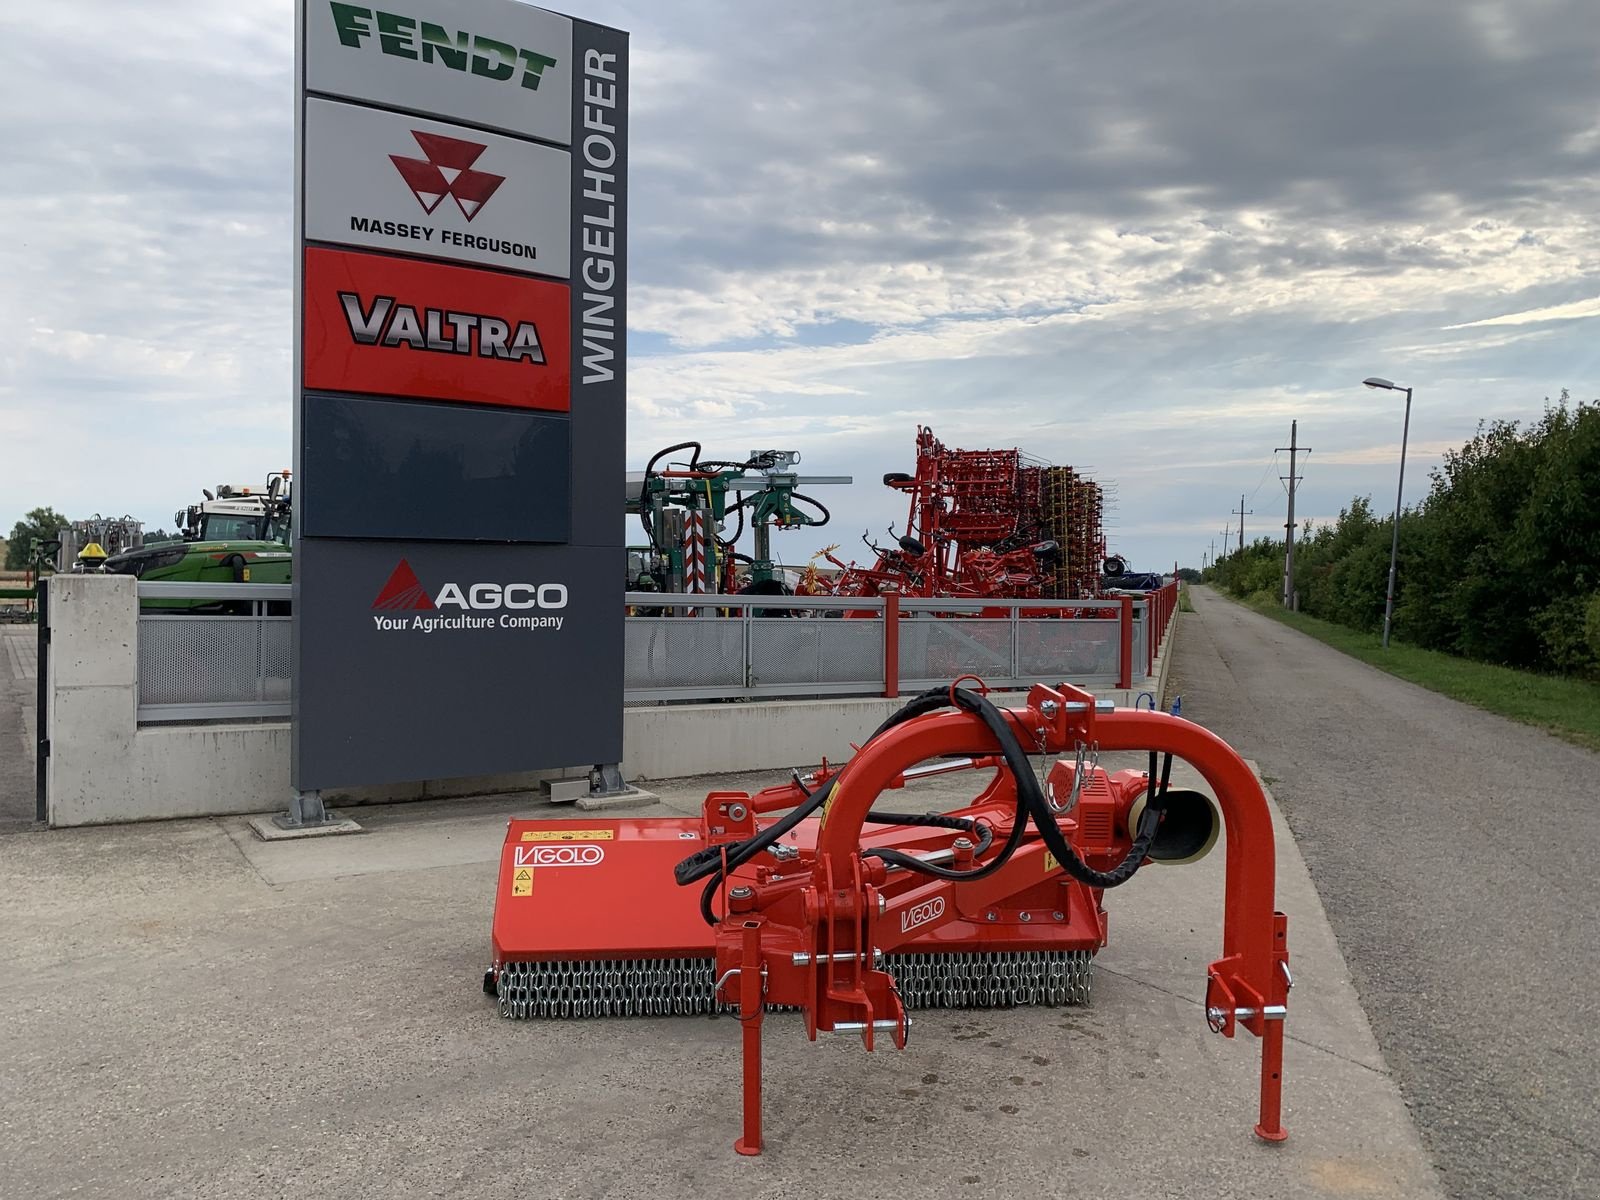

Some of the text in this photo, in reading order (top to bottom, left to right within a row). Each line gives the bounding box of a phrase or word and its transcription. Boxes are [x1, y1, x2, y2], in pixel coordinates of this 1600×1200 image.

[330, 1, 557, 91] FENDT
[582, 48, 617, 385] WINGELHOFER
[350, 216, 537, 260] MASSEY FERGUSON
[337, 291, 547, 365] VALTRA
[434, 583, 568, 610] AGCO
[373, 614, 564, 633] Your Agriculture Company
[514, 844, 604, 867] VIGOLO
[901, 896, 945, 933] VIGOLO
